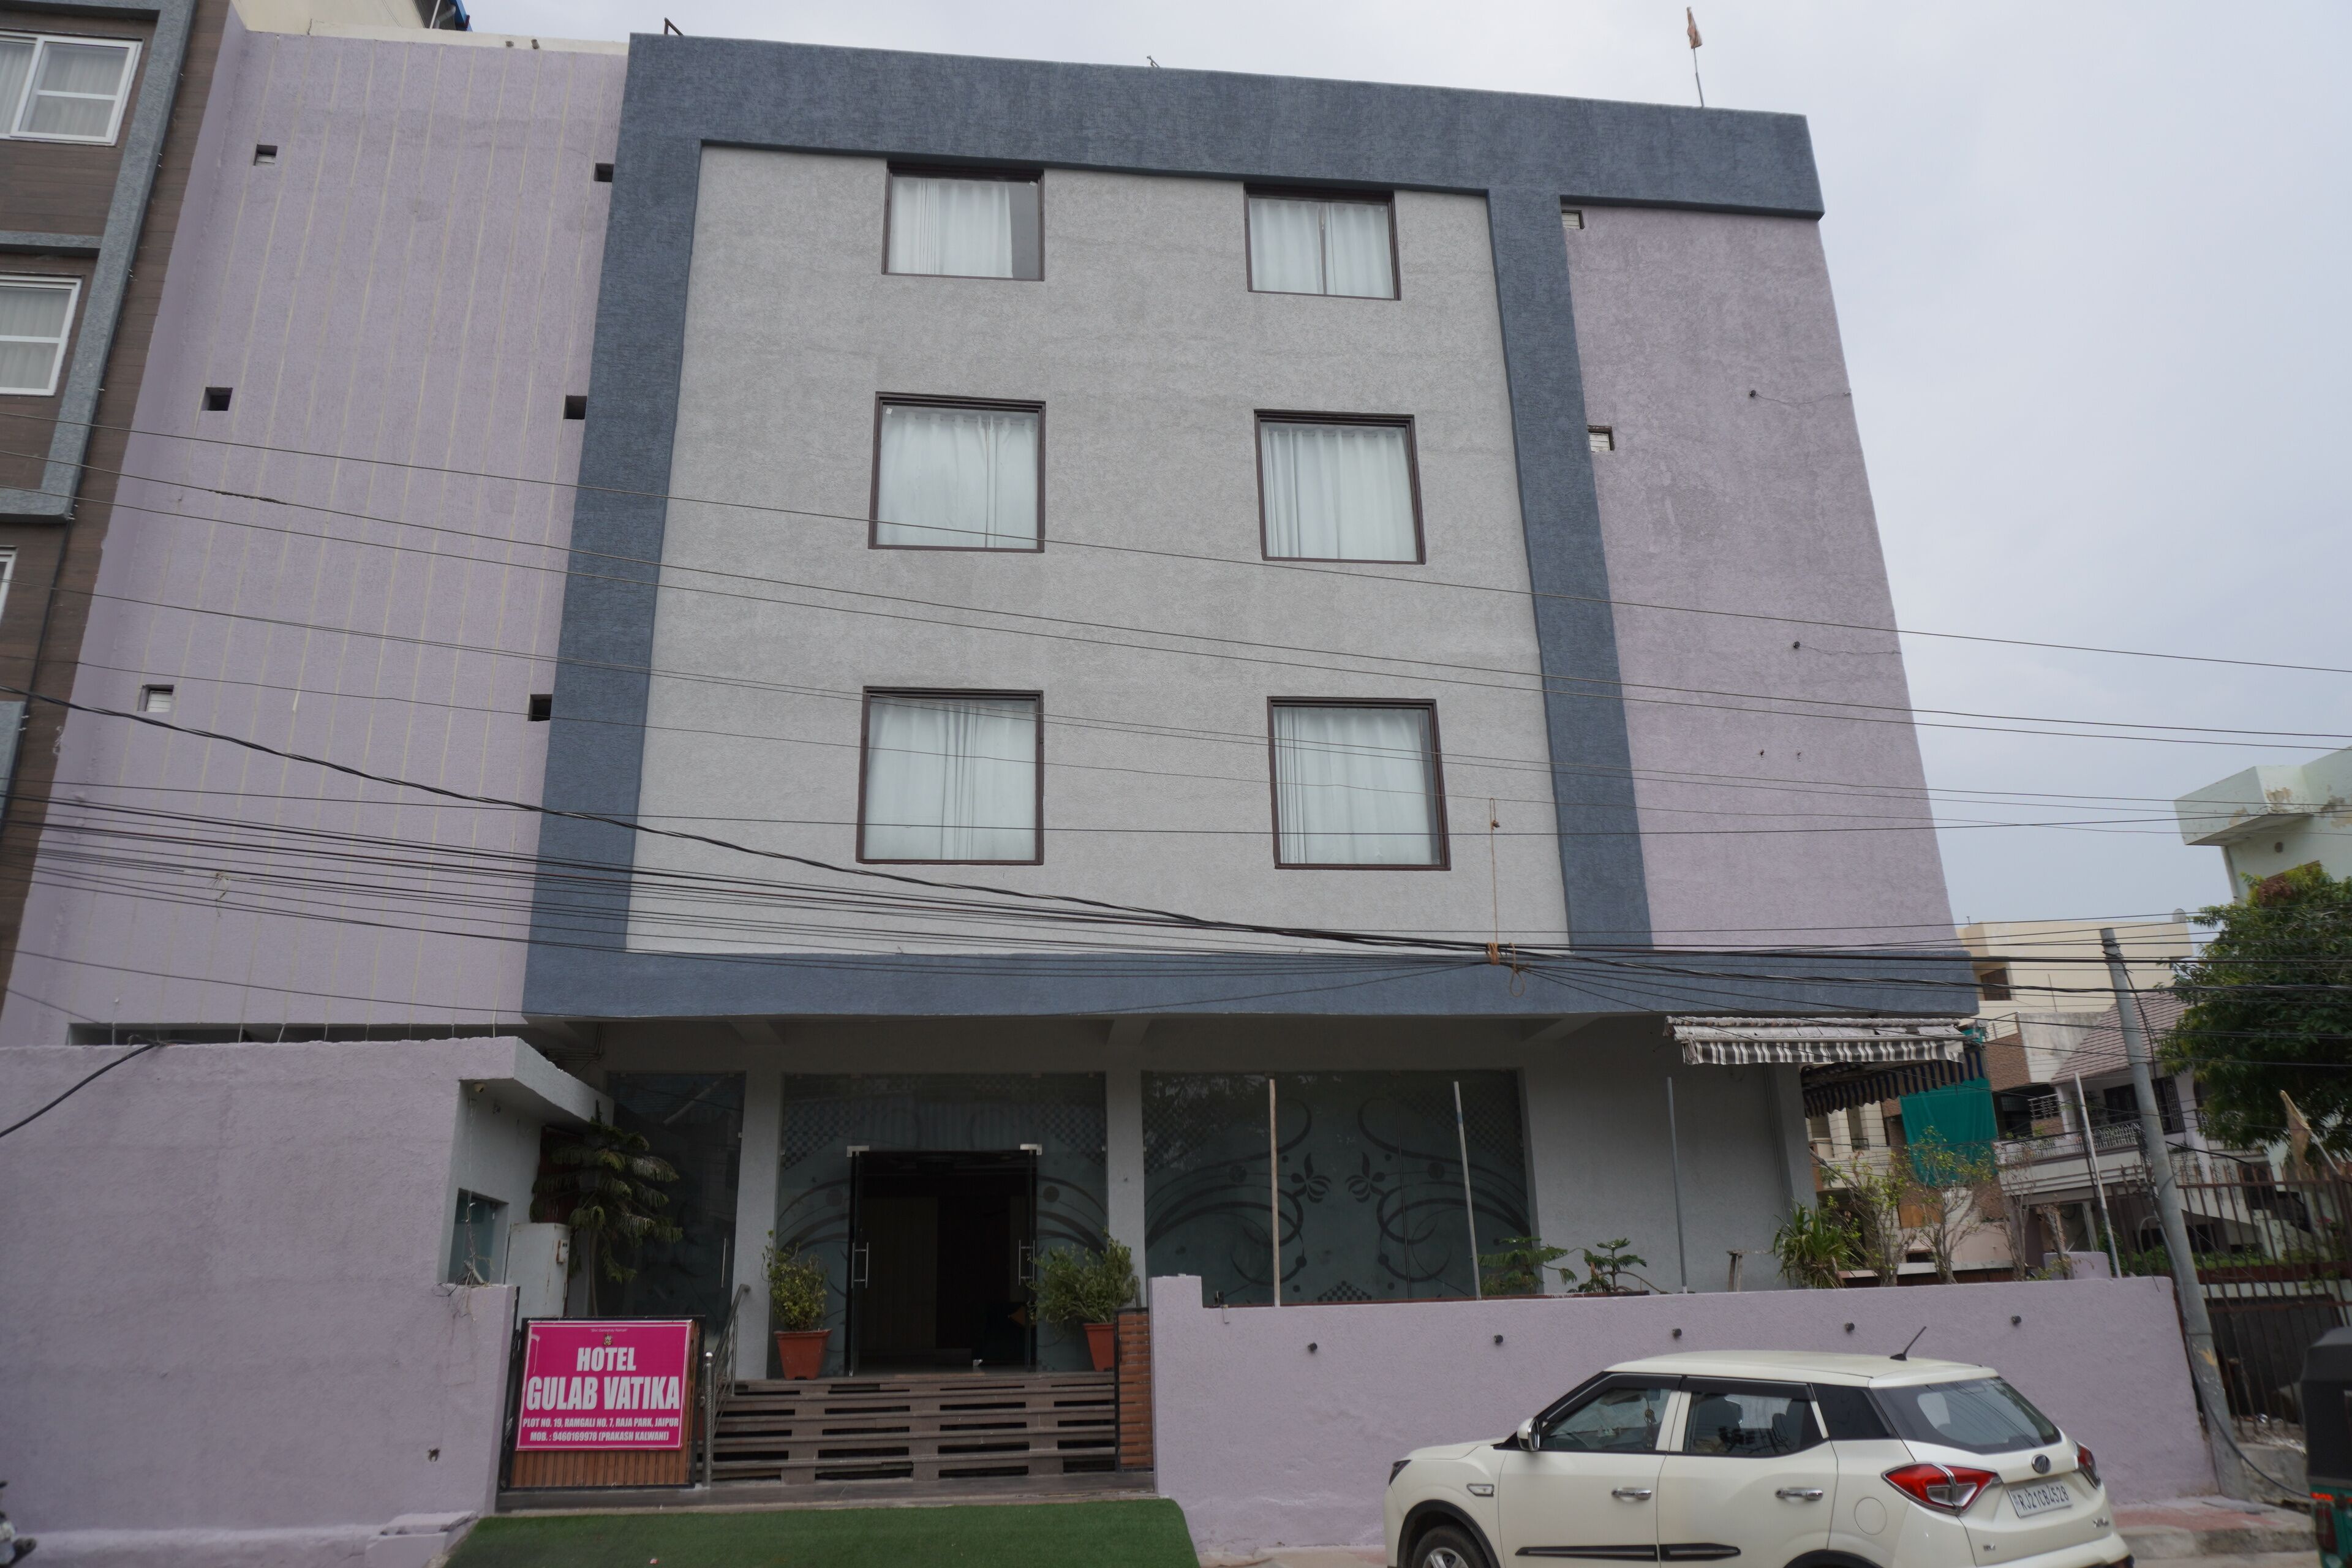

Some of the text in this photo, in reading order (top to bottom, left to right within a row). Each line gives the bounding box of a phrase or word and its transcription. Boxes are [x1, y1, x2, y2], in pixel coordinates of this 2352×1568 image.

[576, 1347, 636, 1371] HOTEL
[526, 1376, 680, 1411] GULAB VATIKA
[522, 1417, 679, 1428] PLOT NO. 19, RAMGALI NO. 7, RAJA PARK, JAIPUR
[530, 1431, 548, 1441] MOB.
[552, 1431, 597, 1441] 9460169978
[598, 1431, 634, 1441] (PRAKASH
[635, 1431, 669, 1441] KALWANI)
[2017, 1485, 2069, 1511] RJ21CB4528
